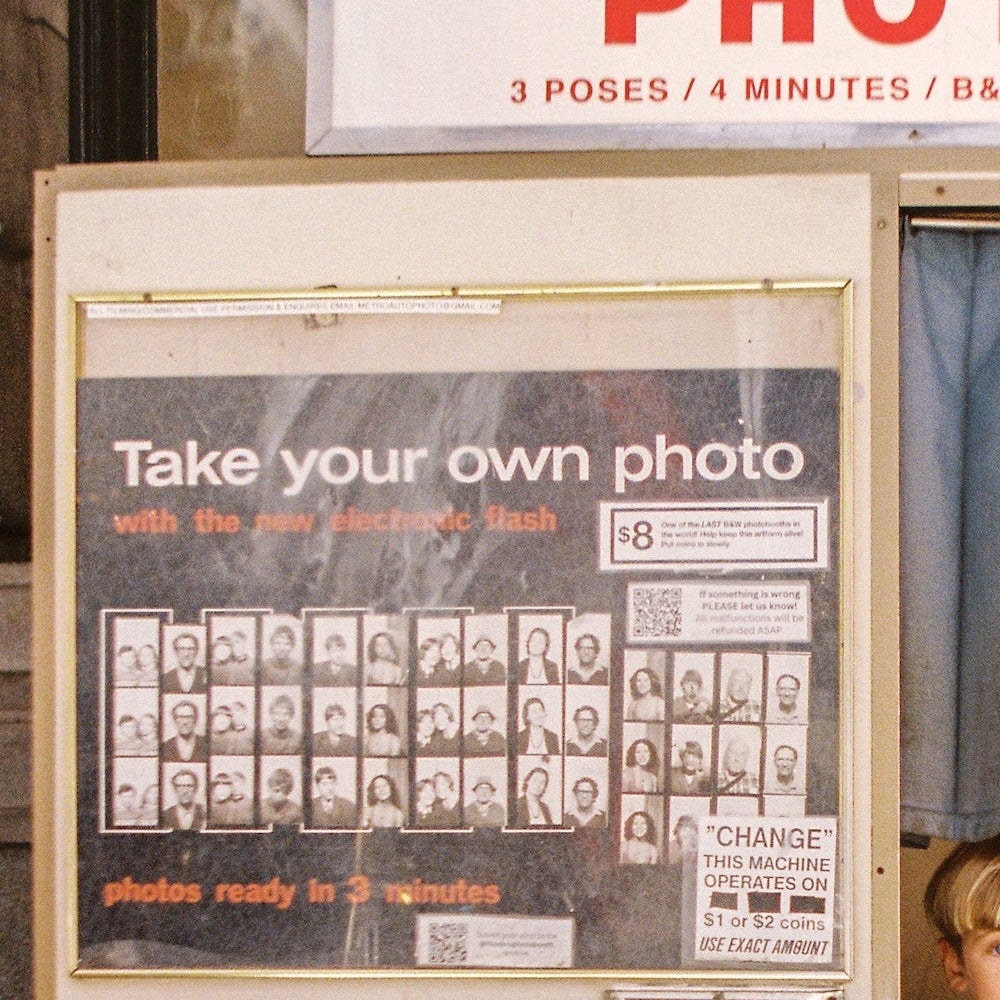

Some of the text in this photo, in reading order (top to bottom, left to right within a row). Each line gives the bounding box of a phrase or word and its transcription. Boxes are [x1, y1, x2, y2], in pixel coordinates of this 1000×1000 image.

[510, 79, 528, 104] 3
[545, 78, 669, 104] POSES
[684, 77, 697, 102] /
[710, 79, 728, 102] 4
[745, 77, 910, 102] MINUTES
[925, 77, 938, 101] /
[113, 434, 805, 497] Take your own photo
[113, 507, 178, 534] with
[193, 508, 241, 533] the
[254, 514, 316, 533] new
[486, 505, 558, 532] flash
[661, 521, 678, 530] One
[688, 521, 702, 529] the
[702, 521, 722, 529] LAST
[723, 520, 742, 529] B&W
[617, 520, 655, 551] $8
[699, 589, 802, 601] If something is wrong
[702, 602, 739, 612] PLEASE
[741, 602, 755, 611] let
[769, 602, 798, 611] know!
[711, 613, 772, 623] malfunctions
[774, 613, 790, 623] will
[792, 613, 805, 623] be
[711, 625, 756, 636] refunded
[703, 853, 831, 873] THIS MACHINE
[704, 873, 829, 892] OPERATES ON
[103, 875, 502, 911] photos ready in 3 minutes
[703, 912, 826, 932] $1 or $2 coins
[699, 936, 726, 953] USE
[727, 937, 772, 954] EXACT
